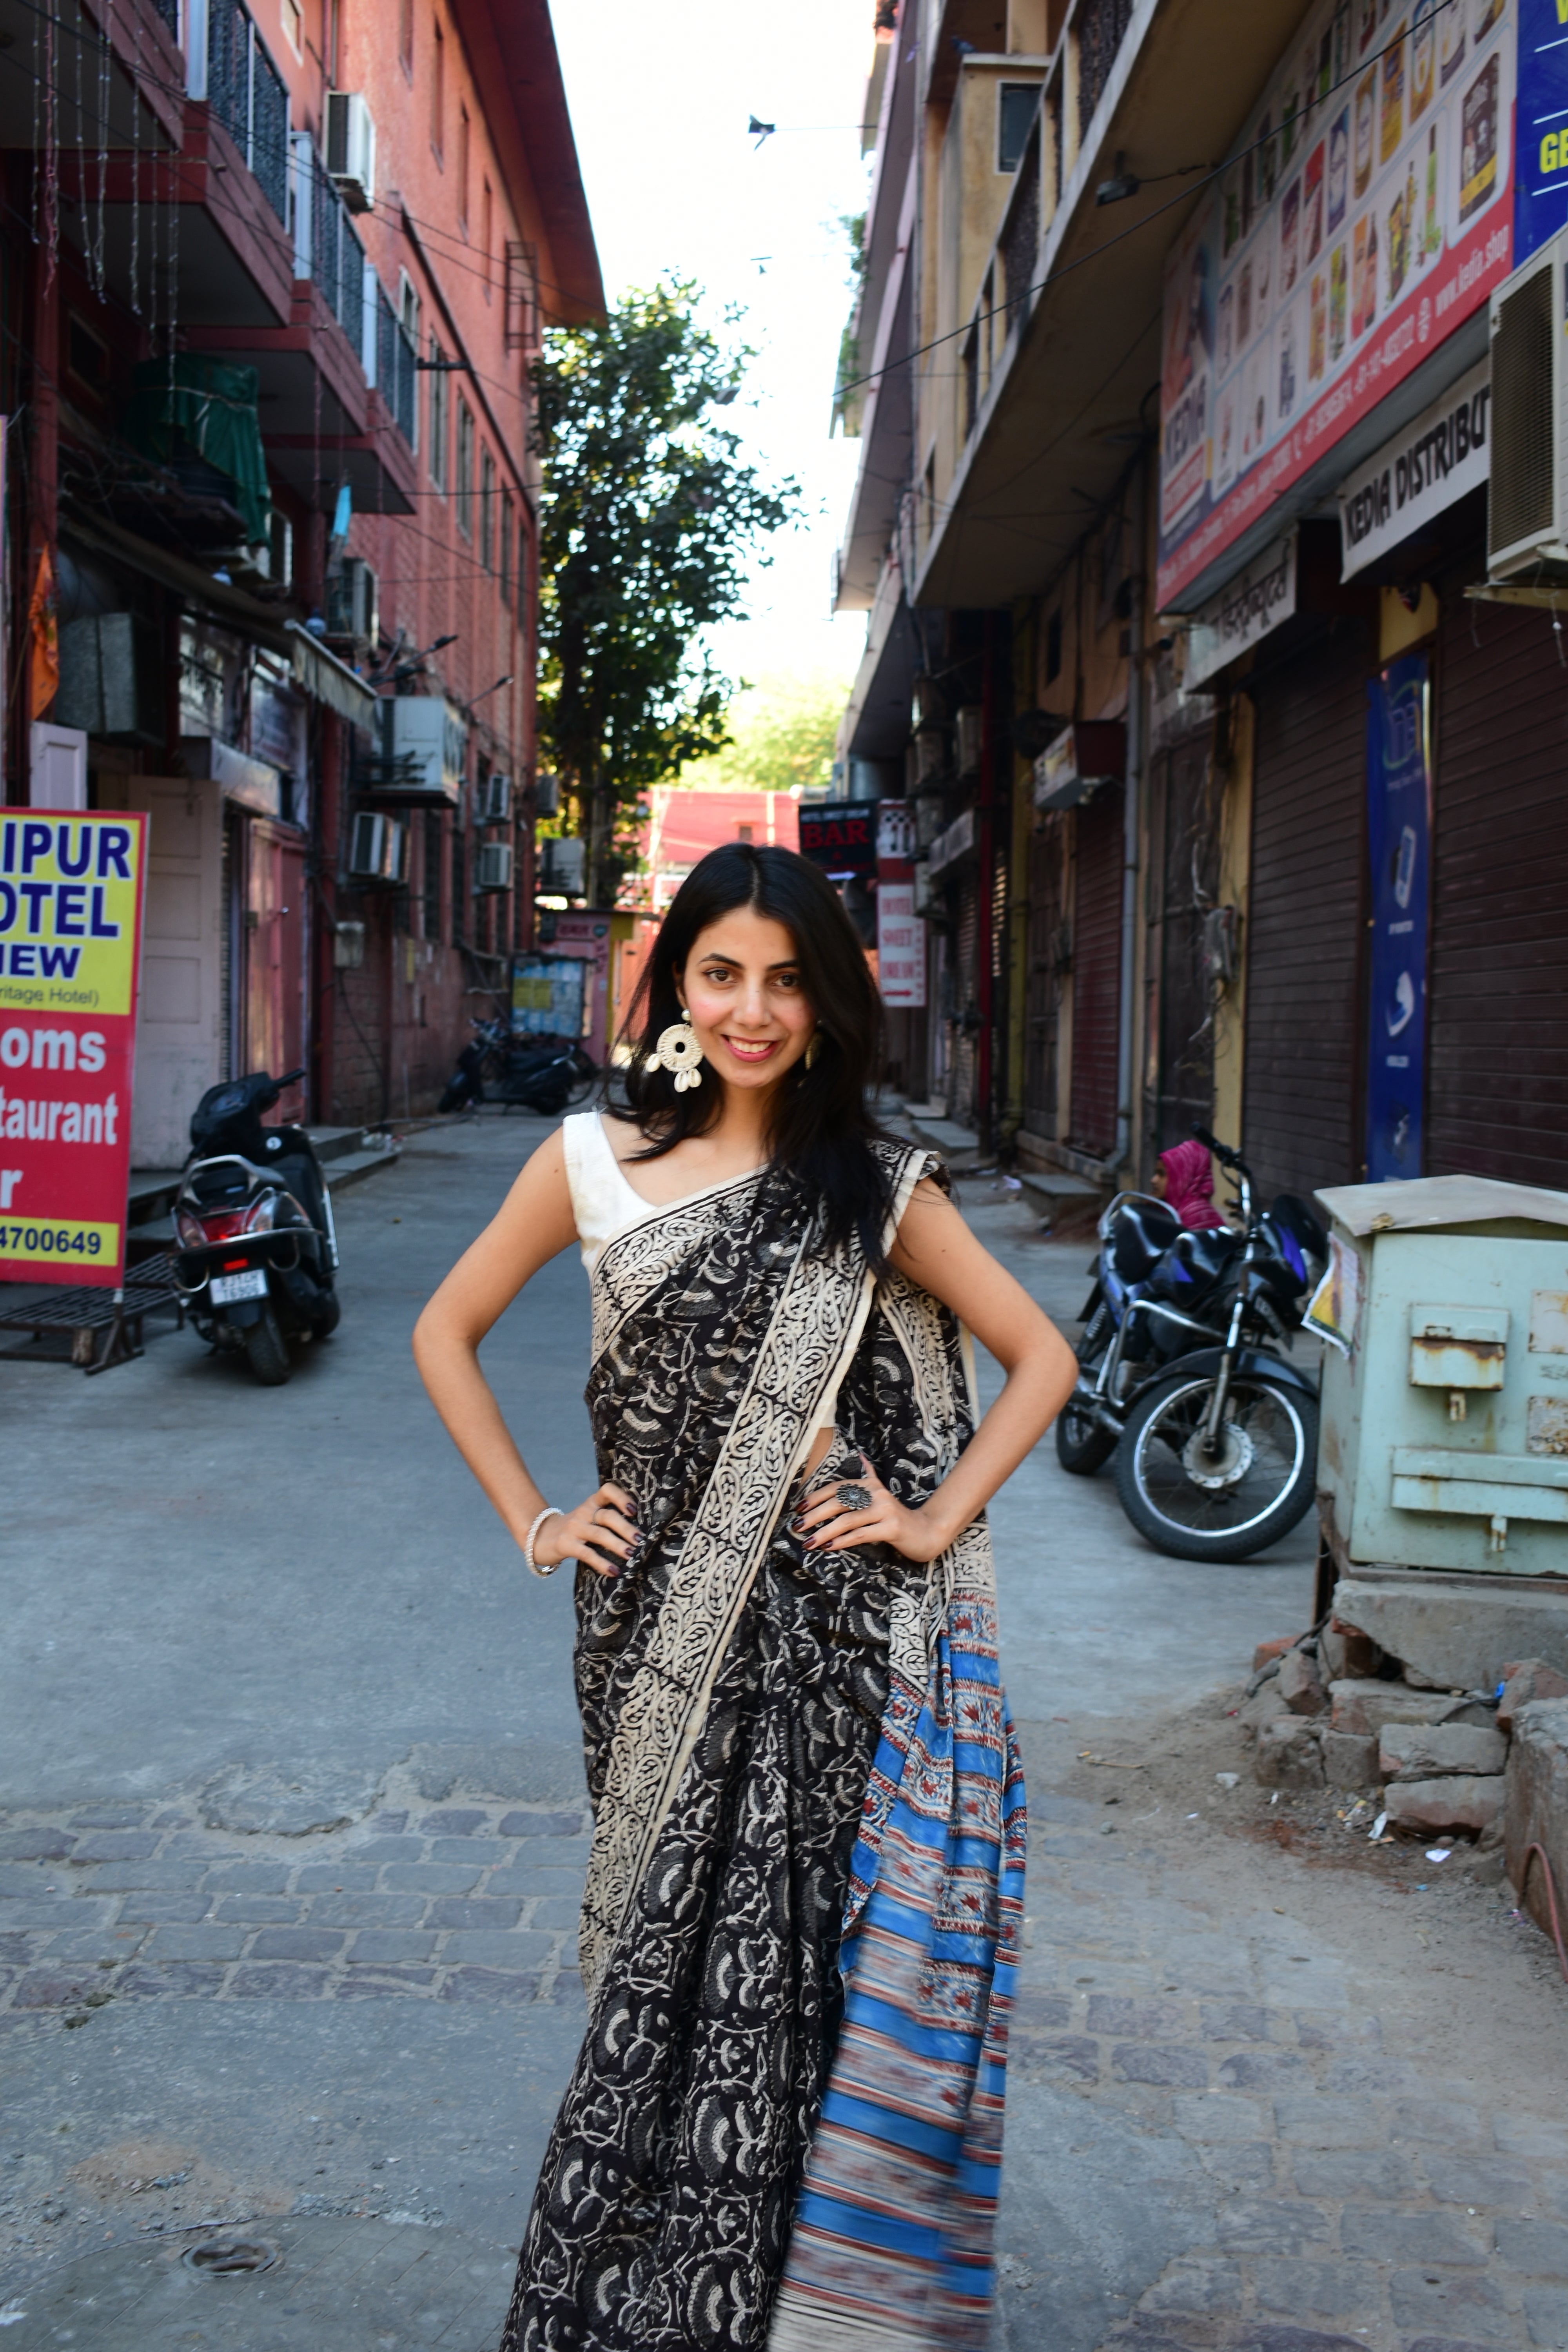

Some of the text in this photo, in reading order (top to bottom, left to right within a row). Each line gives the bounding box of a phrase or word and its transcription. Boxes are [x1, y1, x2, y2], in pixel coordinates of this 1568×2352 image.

[1345, 469, 1390, 550] KEDIA
[4, 822, 131, 878] IPUR
[802, 820, 869, 849] BAR
[49, 987, 99, 1007] Hotel)
[0, 1027, 106, 1073] oms
